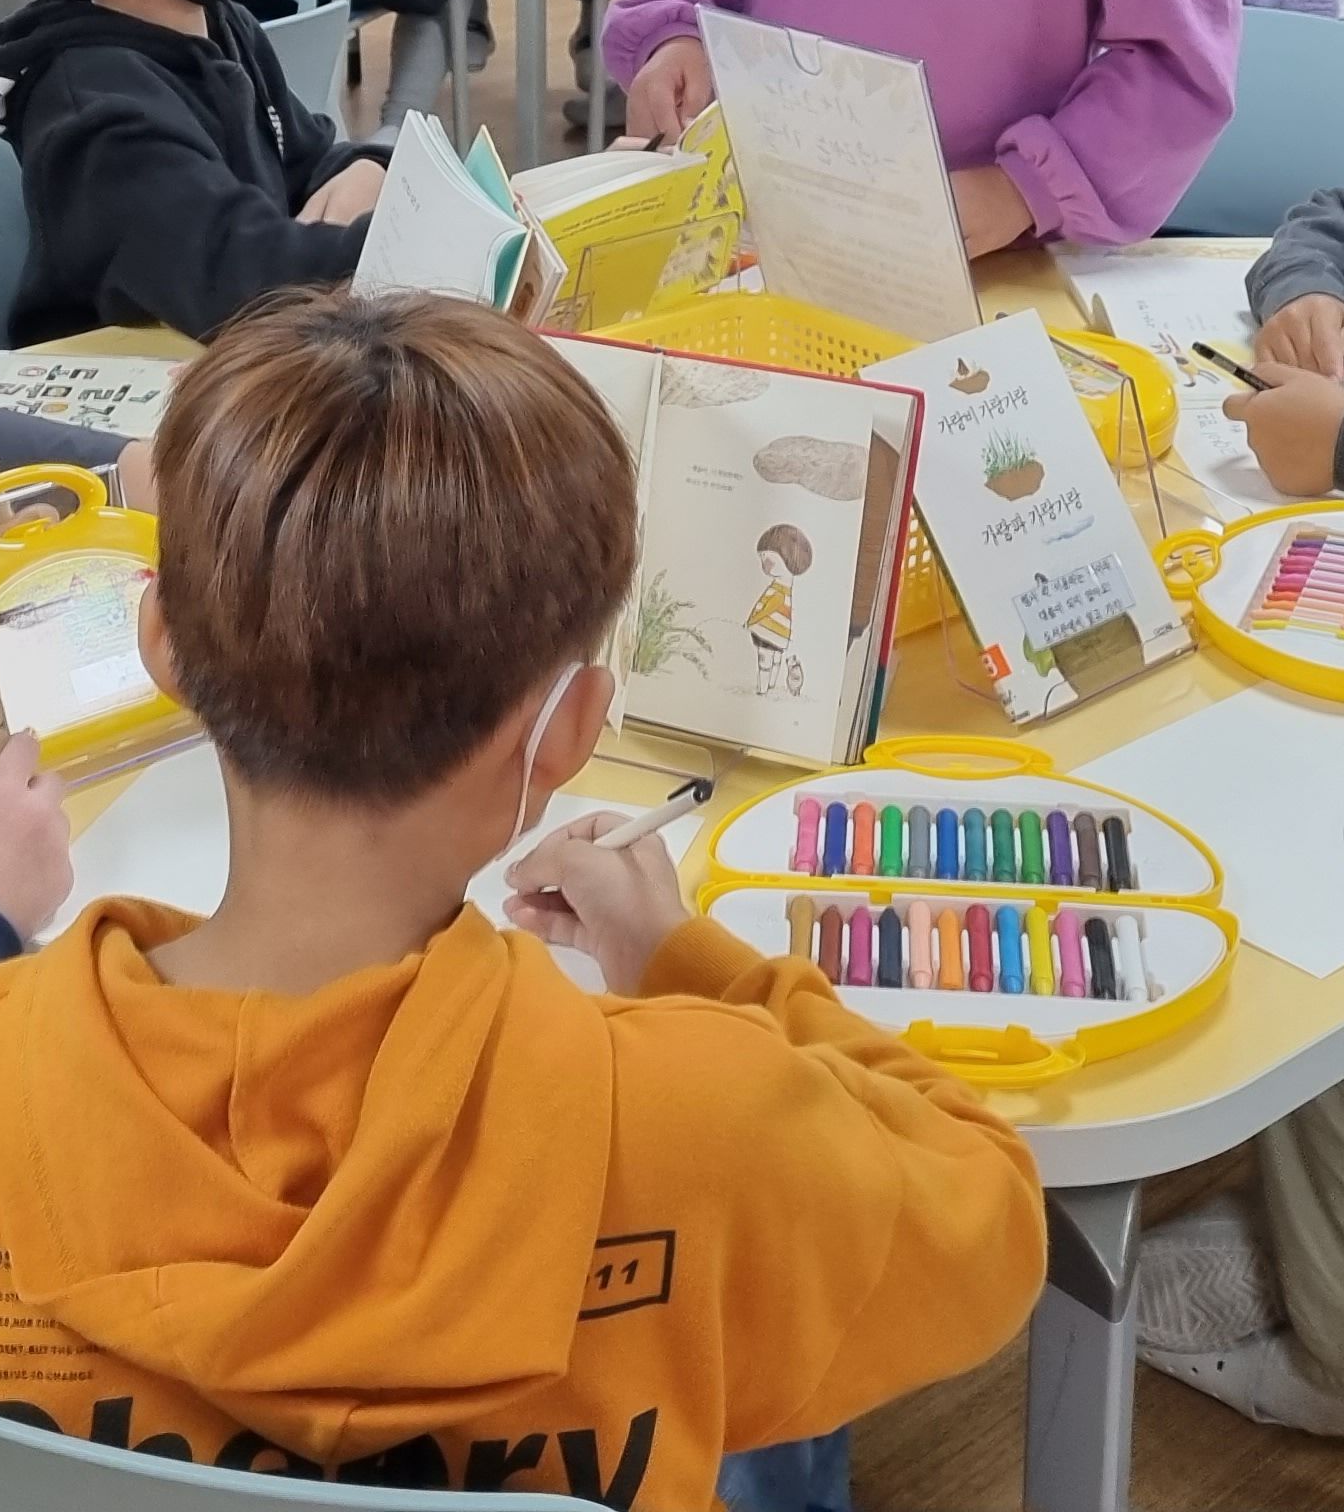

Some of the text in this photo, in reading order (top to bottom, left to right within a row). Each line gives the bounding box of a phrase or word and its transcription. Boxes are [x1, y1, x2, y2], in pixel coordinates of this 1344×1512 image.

[937, 385, 1029, 435] 가랑비 가랑가랑
[982, 487, 1083, 546] 가랑파 가랑가랑
